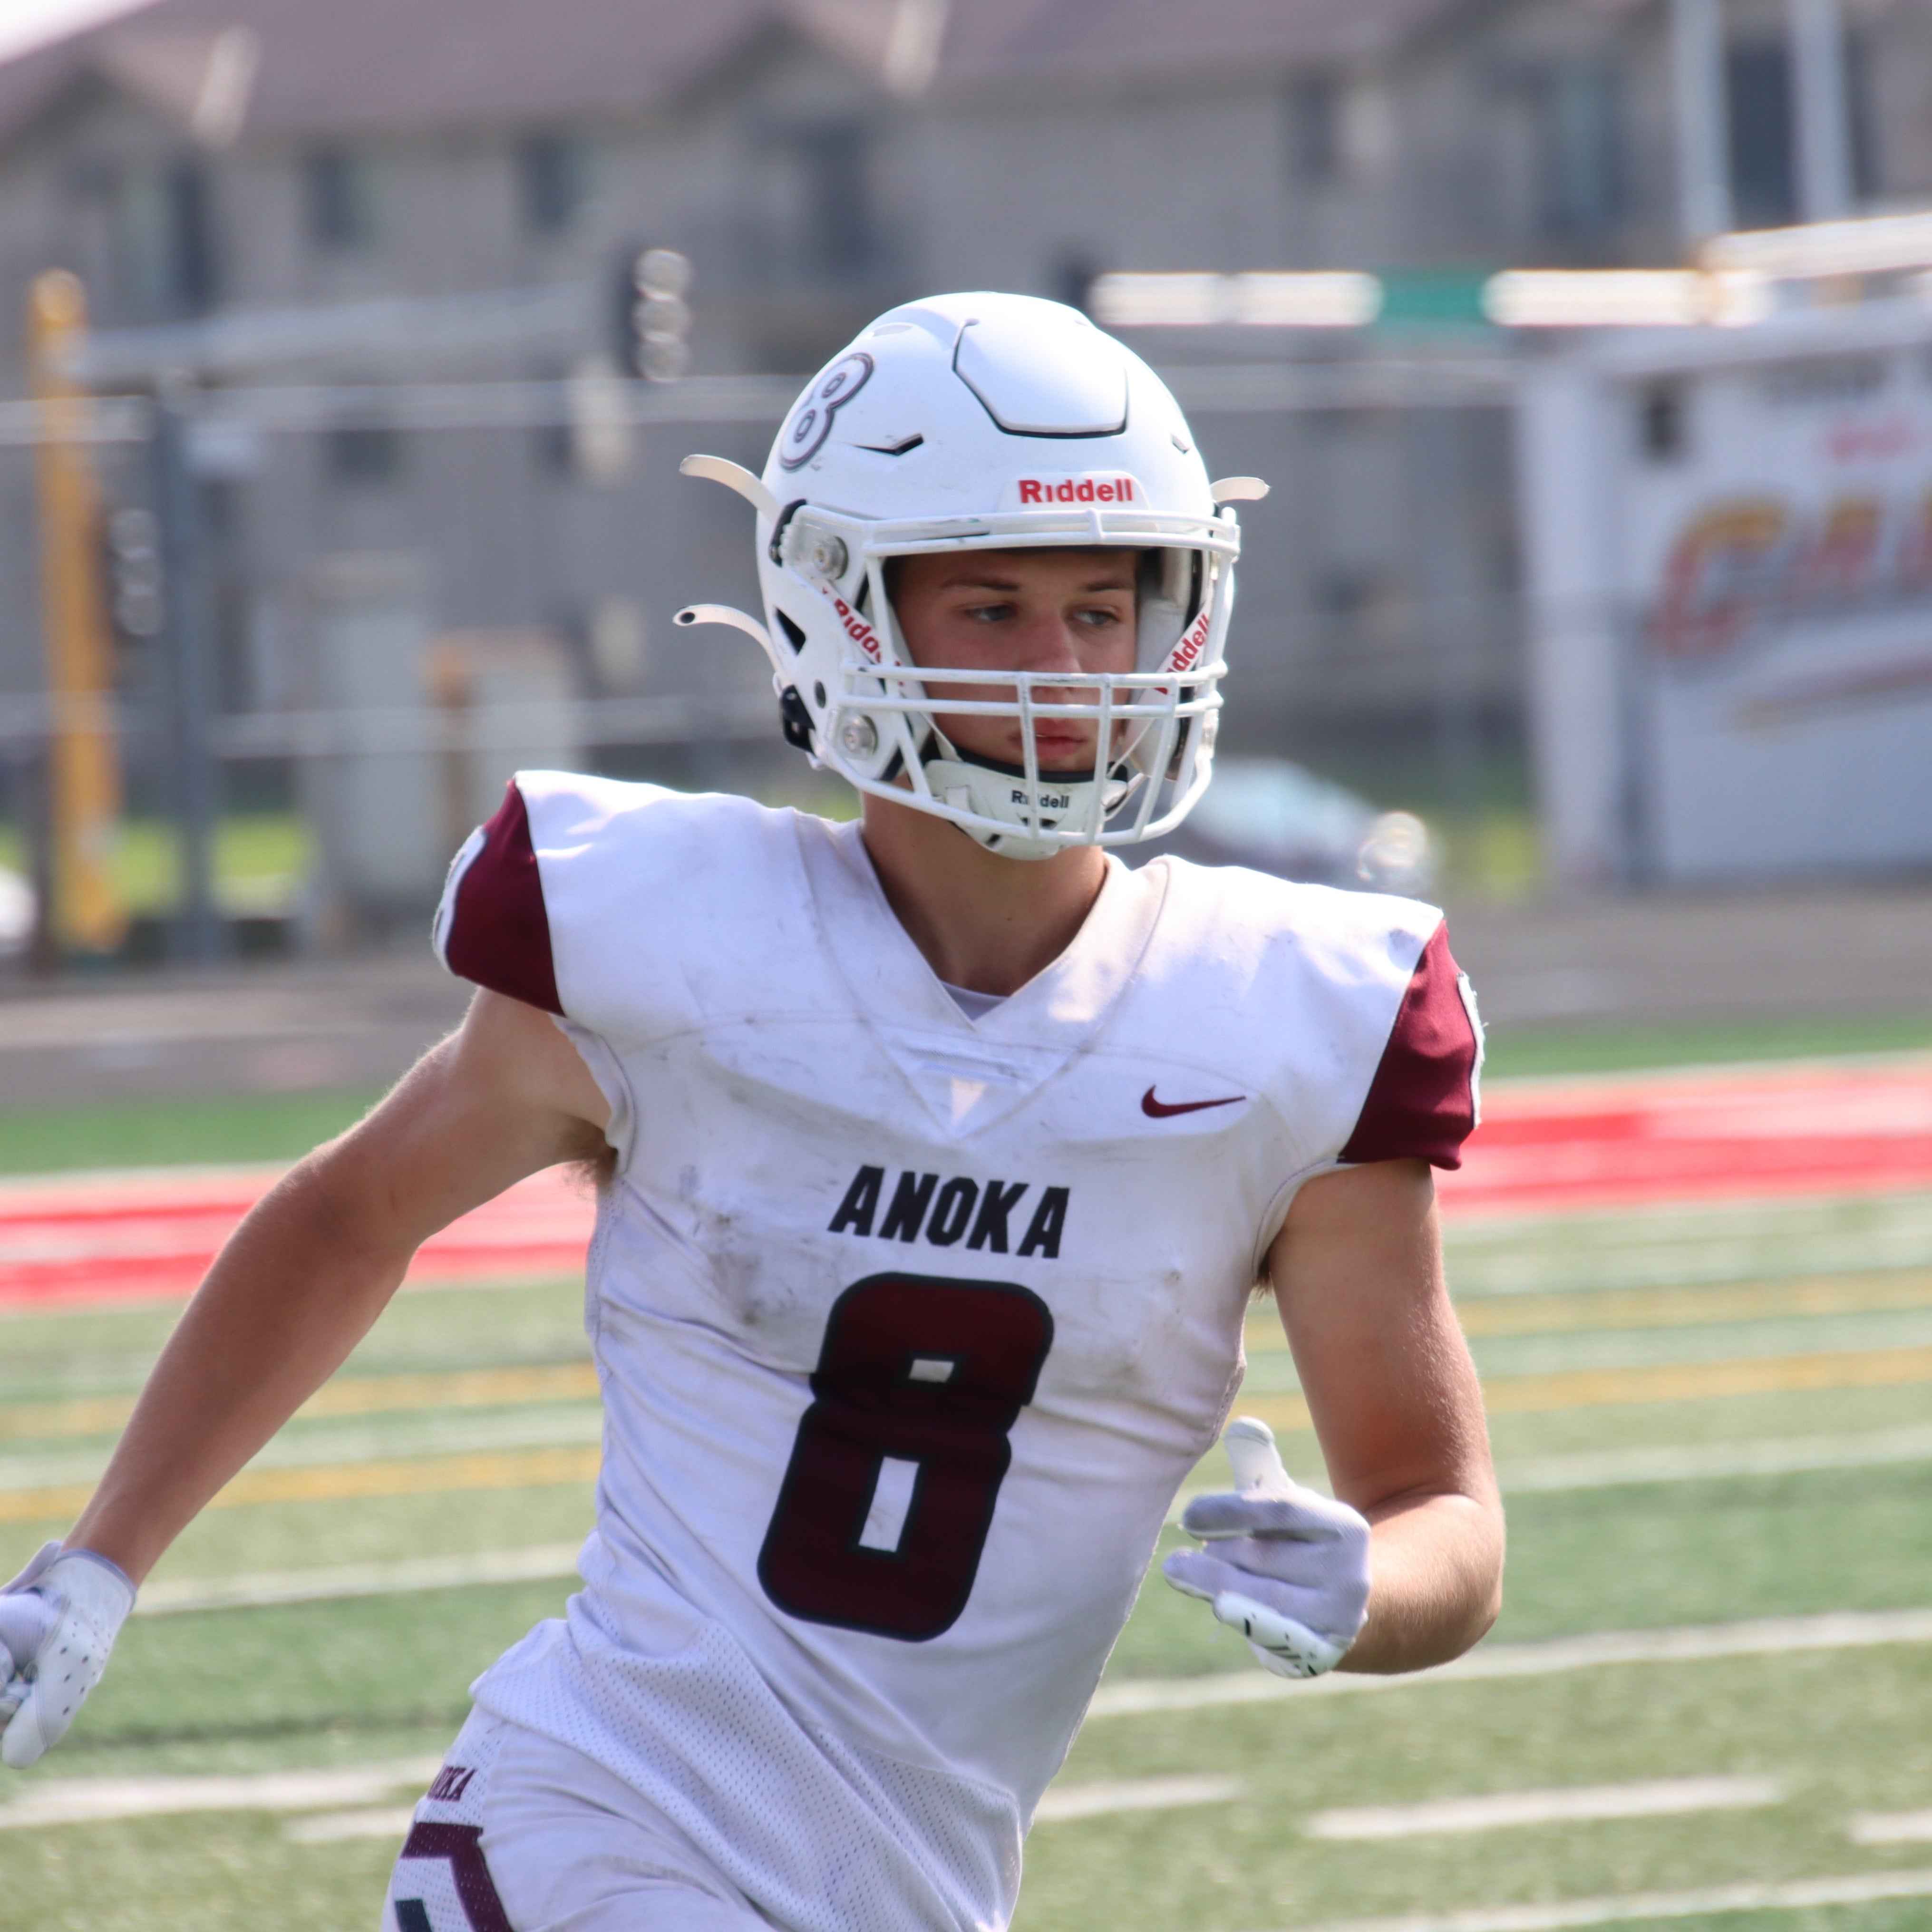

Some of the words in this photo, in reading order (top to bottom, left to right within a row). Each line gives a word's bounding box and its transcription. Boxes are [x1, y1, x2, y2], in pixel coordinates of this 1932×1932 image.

[778, 352, 874, 473] 8
[1018, 478, 1135, 504] Riddell
[827, 1165, 1070, 1259] ANOKA
[757, 1272, 1054, 1642] 8
